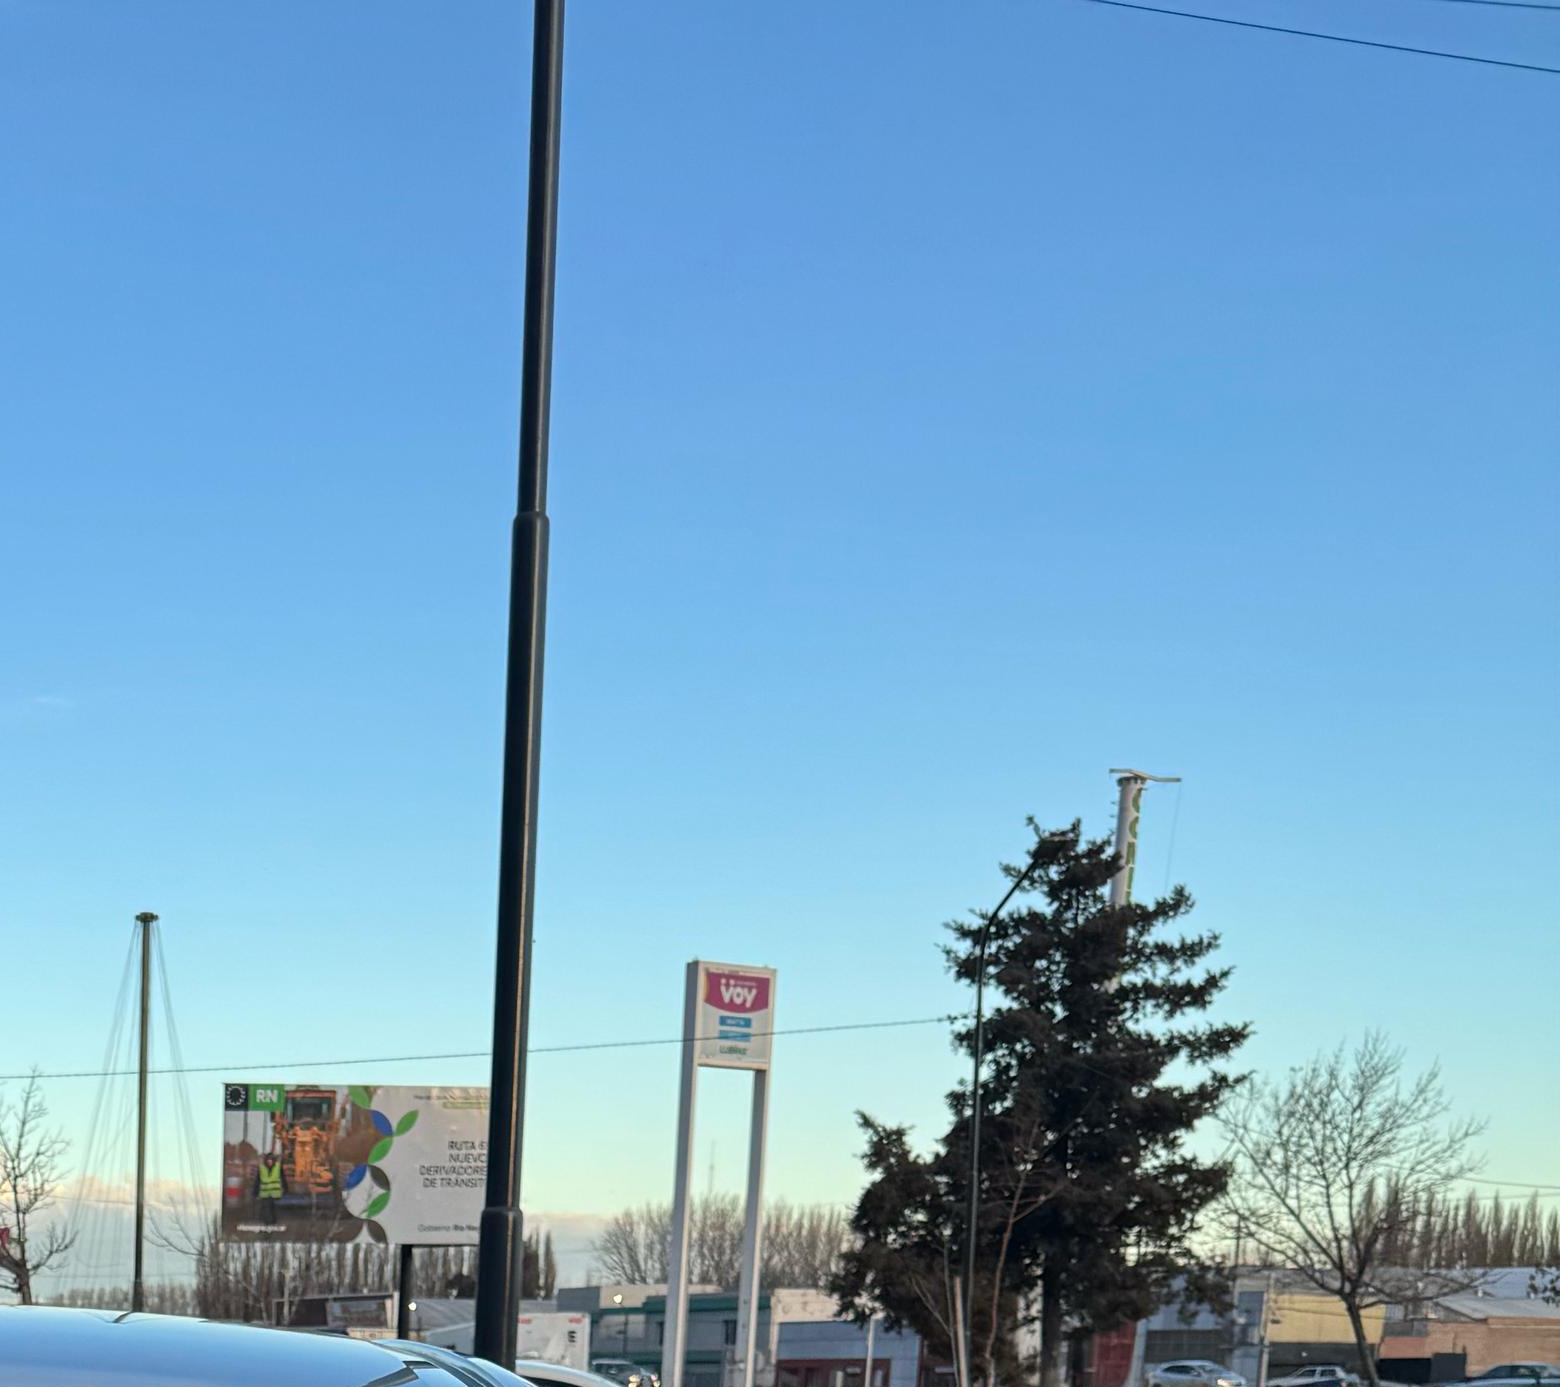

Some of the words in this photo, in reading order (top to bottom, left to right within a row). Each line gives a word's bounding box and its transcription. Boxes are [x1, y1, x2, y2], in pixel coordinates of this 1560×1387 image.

[256, 1089, 278, 1103] RN
[448, 1141, 476, 1151] RUTA
[419, 1165, 488, 1176] DERIVADORE
[422, 1178, 437, 1188] DE
